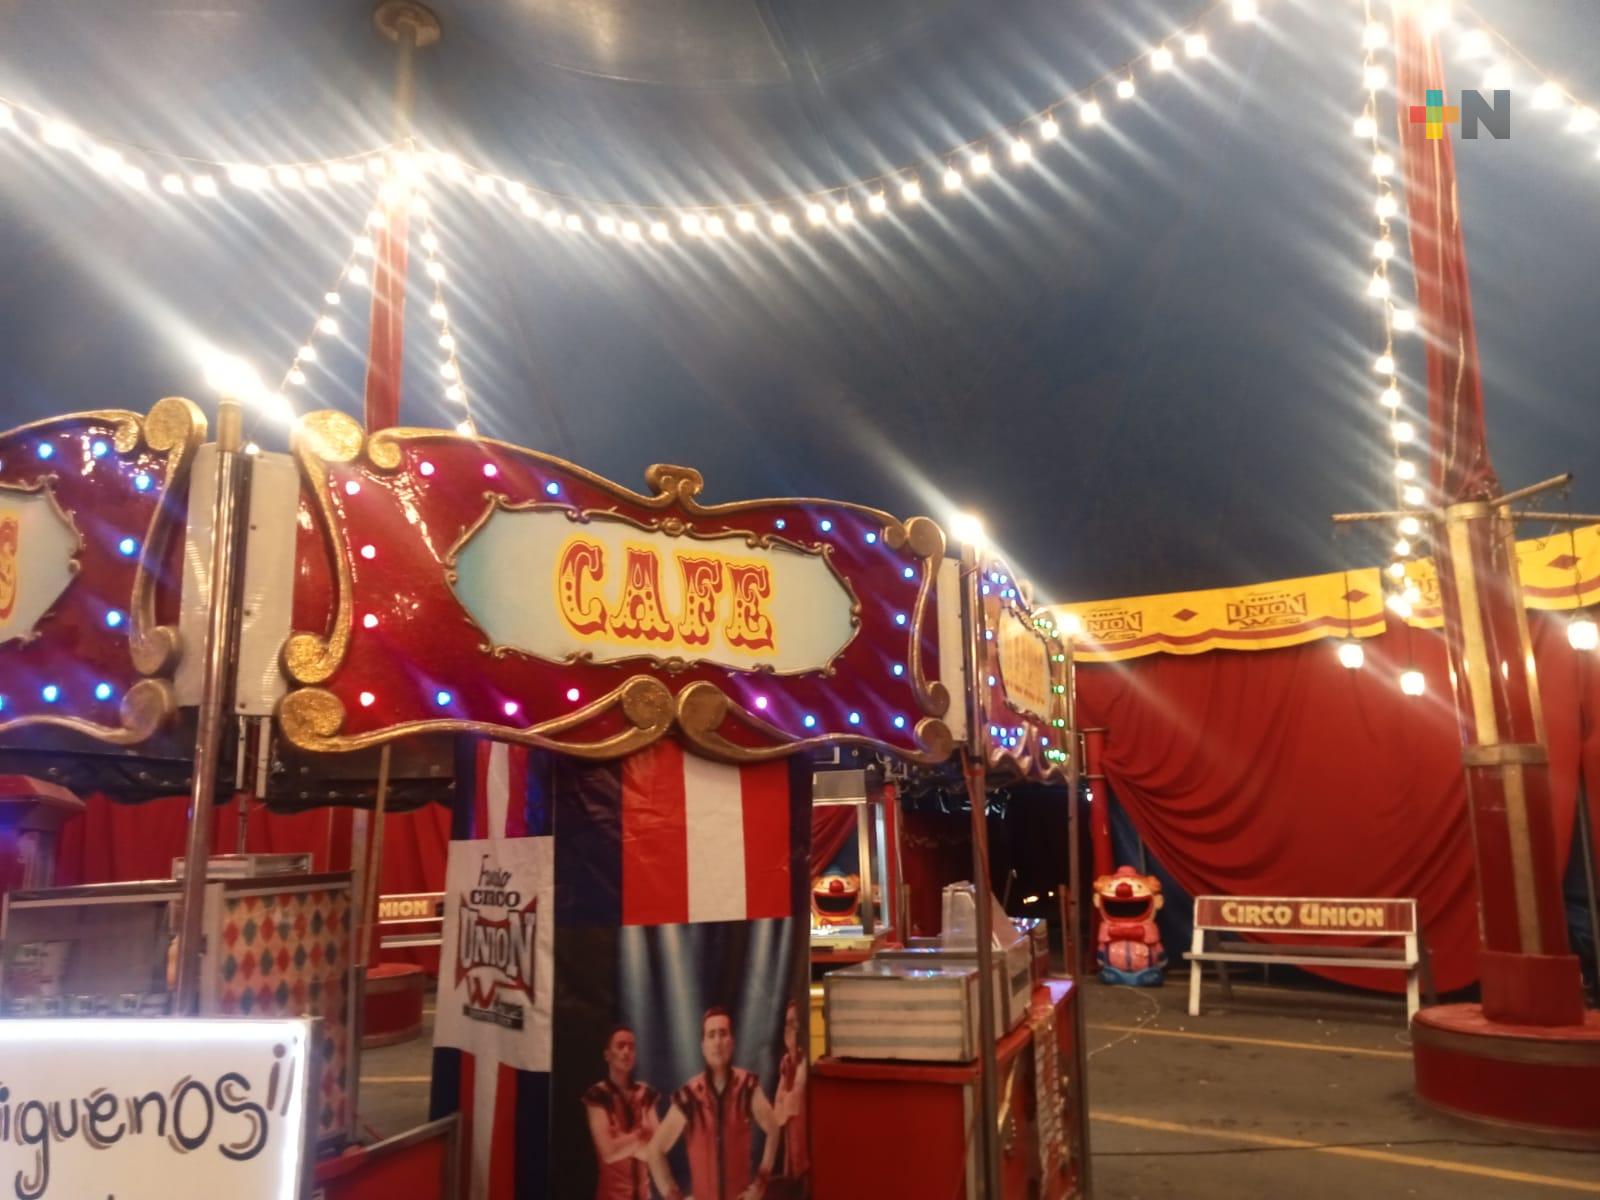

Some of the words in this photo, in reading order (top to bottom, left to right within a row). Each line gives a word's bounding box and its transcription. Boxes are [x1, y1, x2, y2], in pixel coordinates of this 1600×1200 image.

[558, 540, 775, 650] CAFE
[1226, 593, 1307, 624] UNION
[1082, 610, 1143, 633] NION
[1221, 902, 1292, 926] CIRCO
[1300, 903, 1384, 927] UNION
[459, 906, 538, 992] UNION
